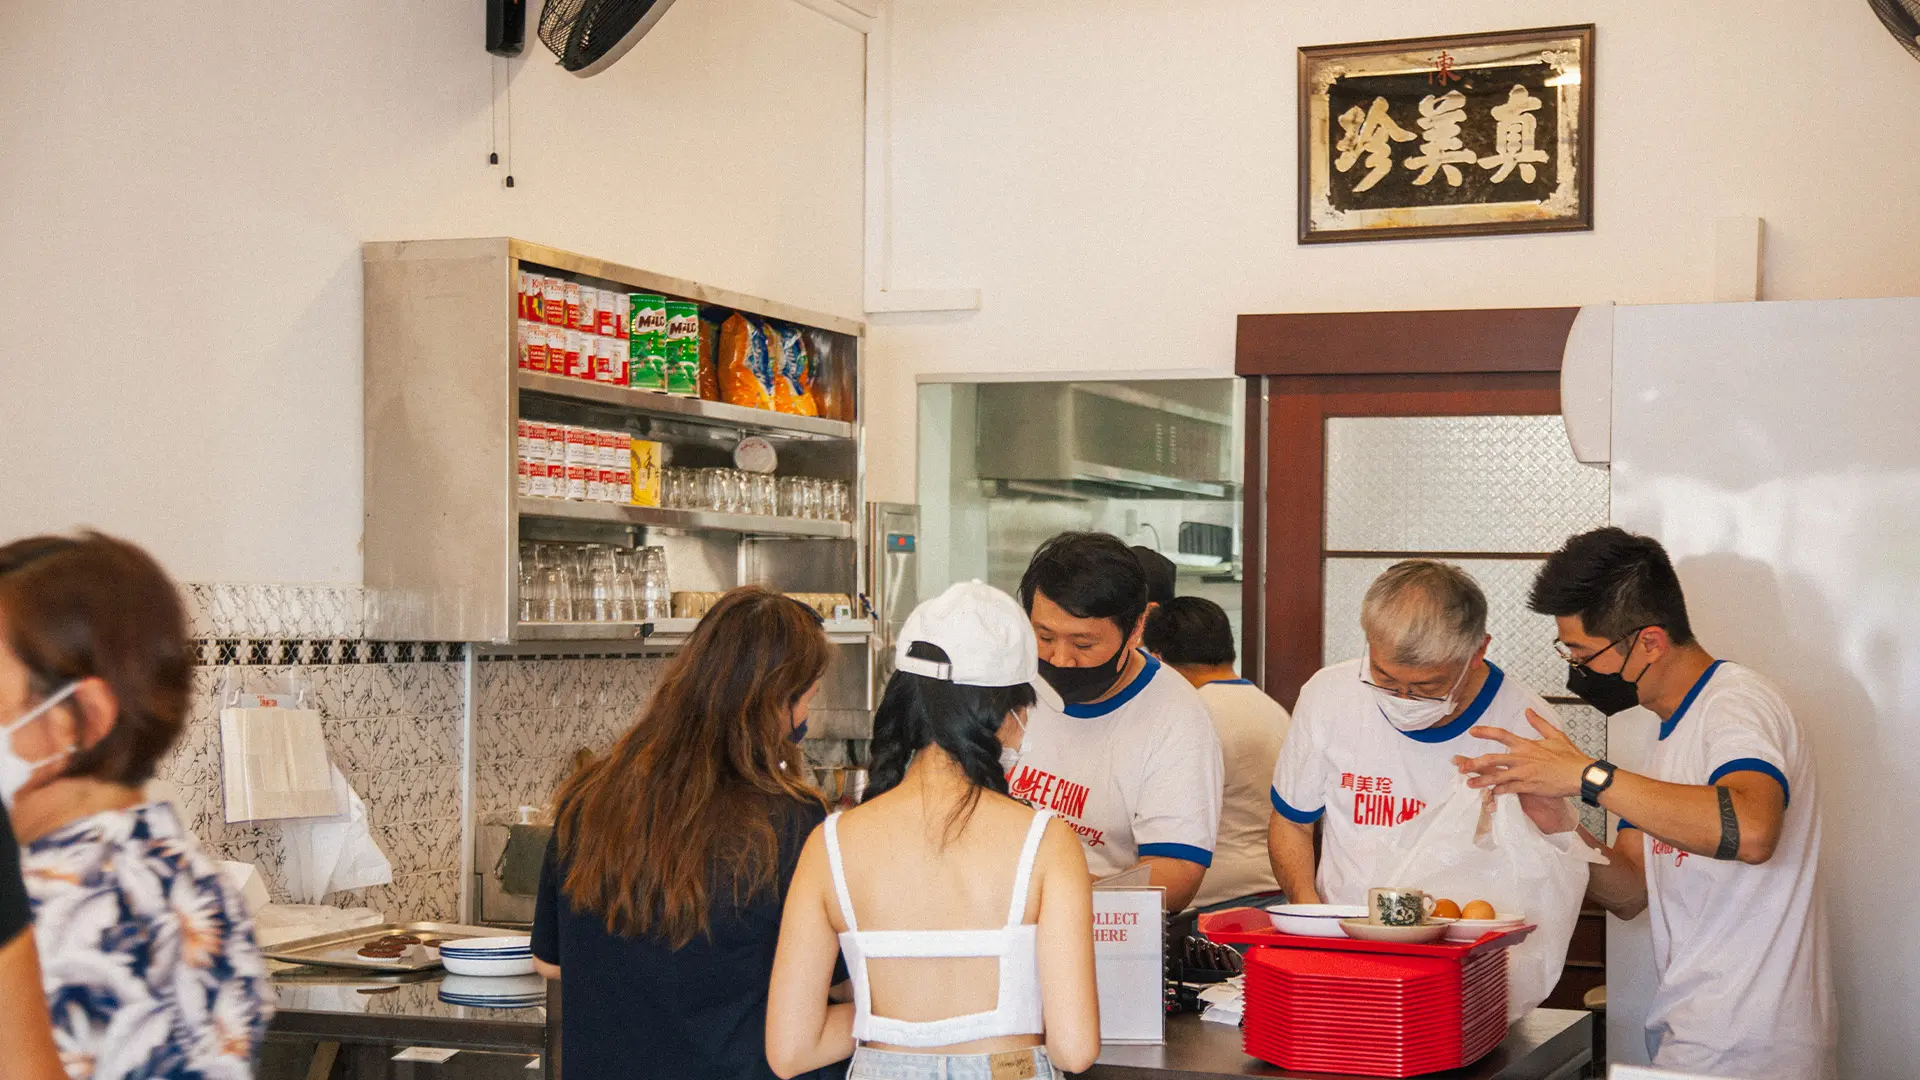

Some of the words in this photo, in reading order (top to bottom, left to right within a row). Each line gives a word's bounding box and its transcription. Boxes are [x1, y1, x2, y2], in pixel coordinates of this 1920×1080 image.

[1051, 778, 1090, 819] CHIN
[1340, 772, 1393, 794] 真美珍
[1353, 793, 1395, 827] CHIN
